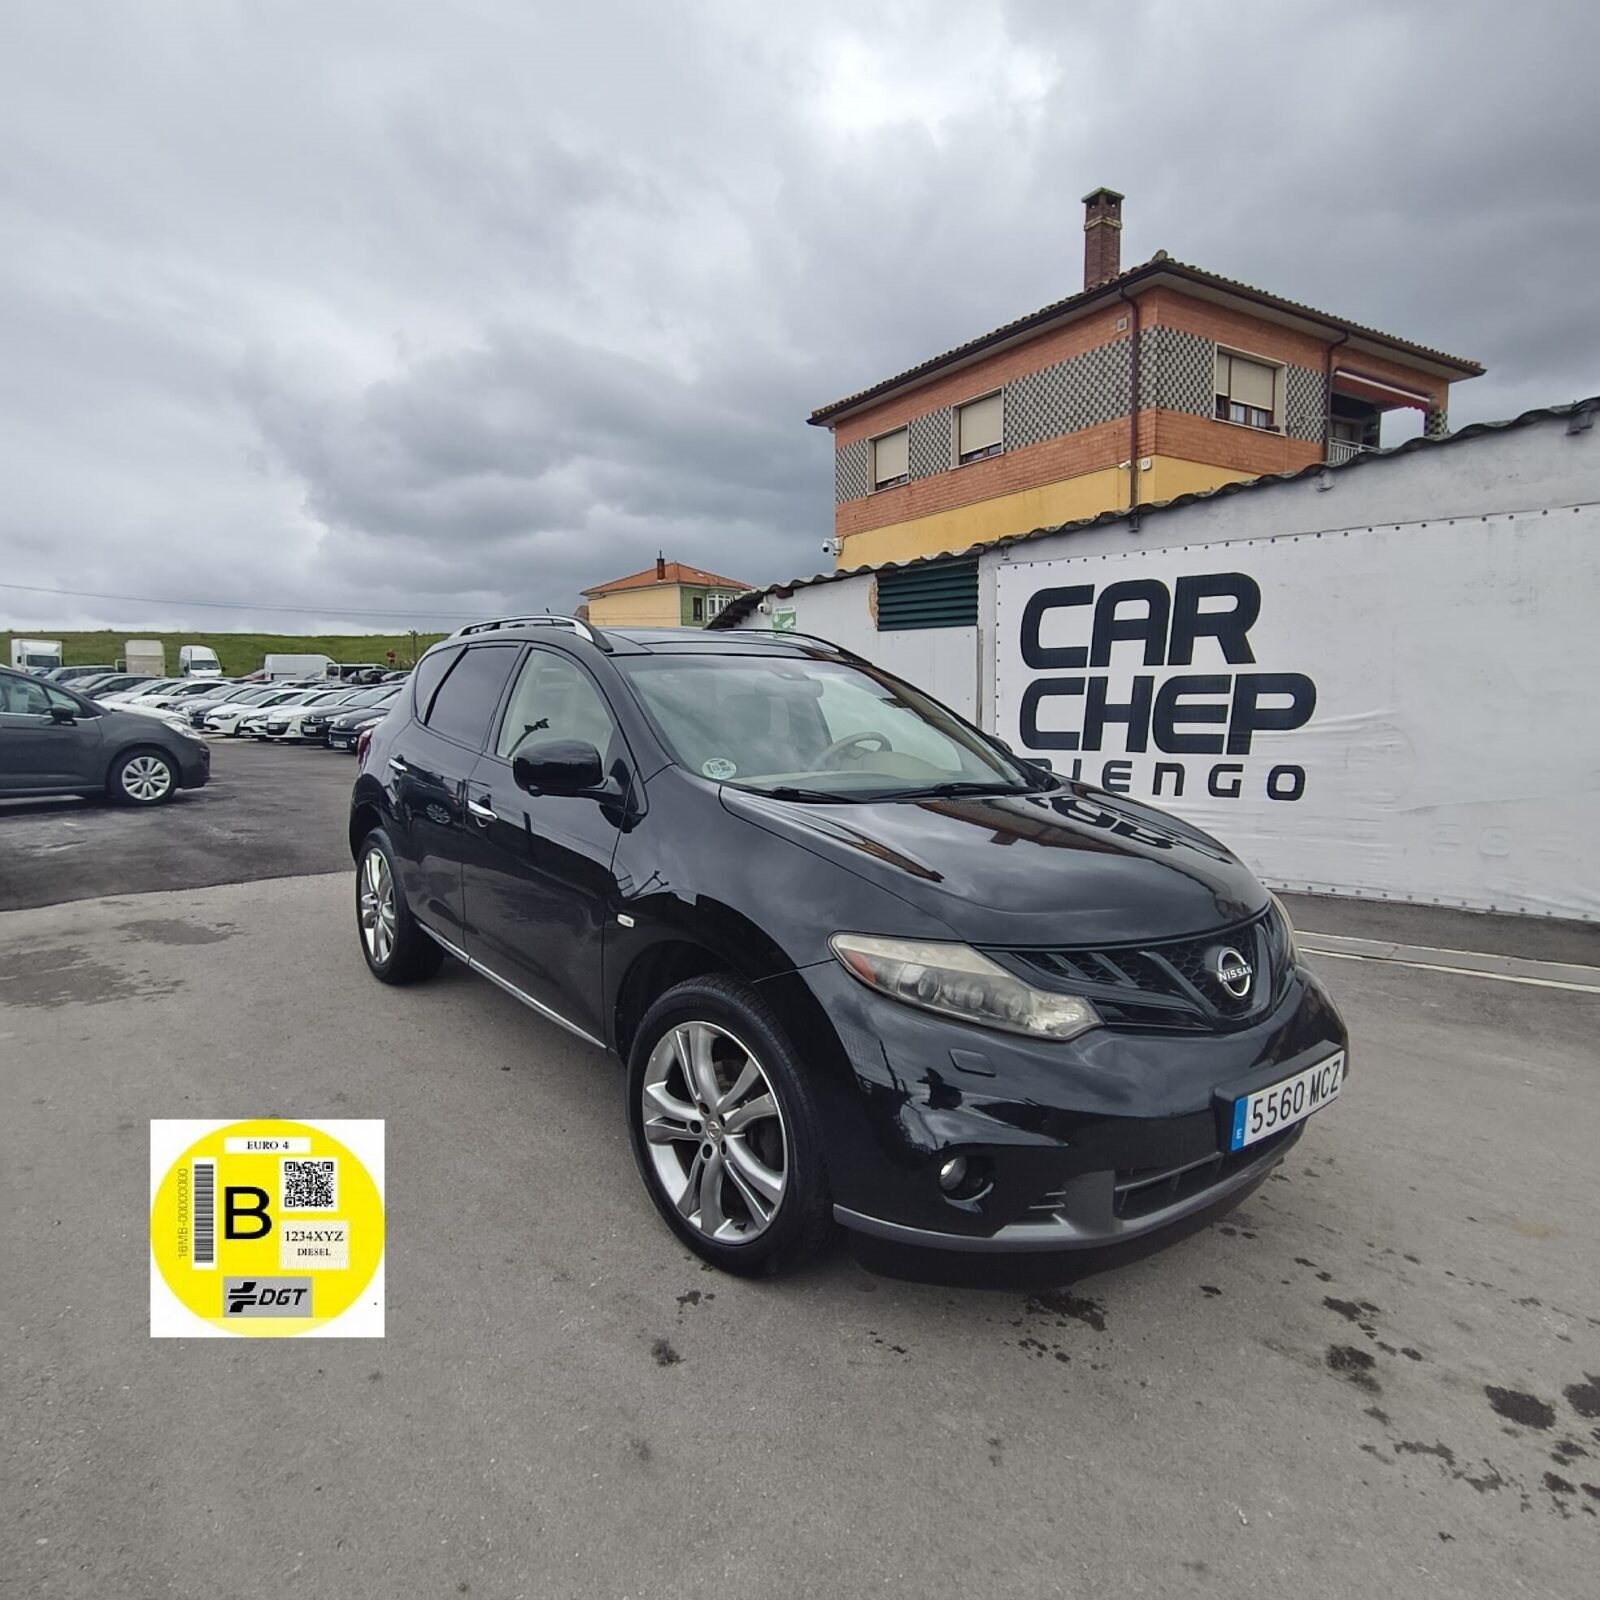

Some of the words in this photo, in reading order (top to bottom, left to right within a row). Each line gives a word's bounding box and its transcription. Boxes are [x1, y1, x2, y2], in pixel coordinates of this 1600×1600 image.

[1020, 572, 1261, 669] CAR
[1019, 672, 1317, 755] CHEP
[1217, 964, 1252, 983] NISSAN
[1251, 1081, 1305, 1134] 5560
[1309, 1059, 1341, 1107] MCZ
